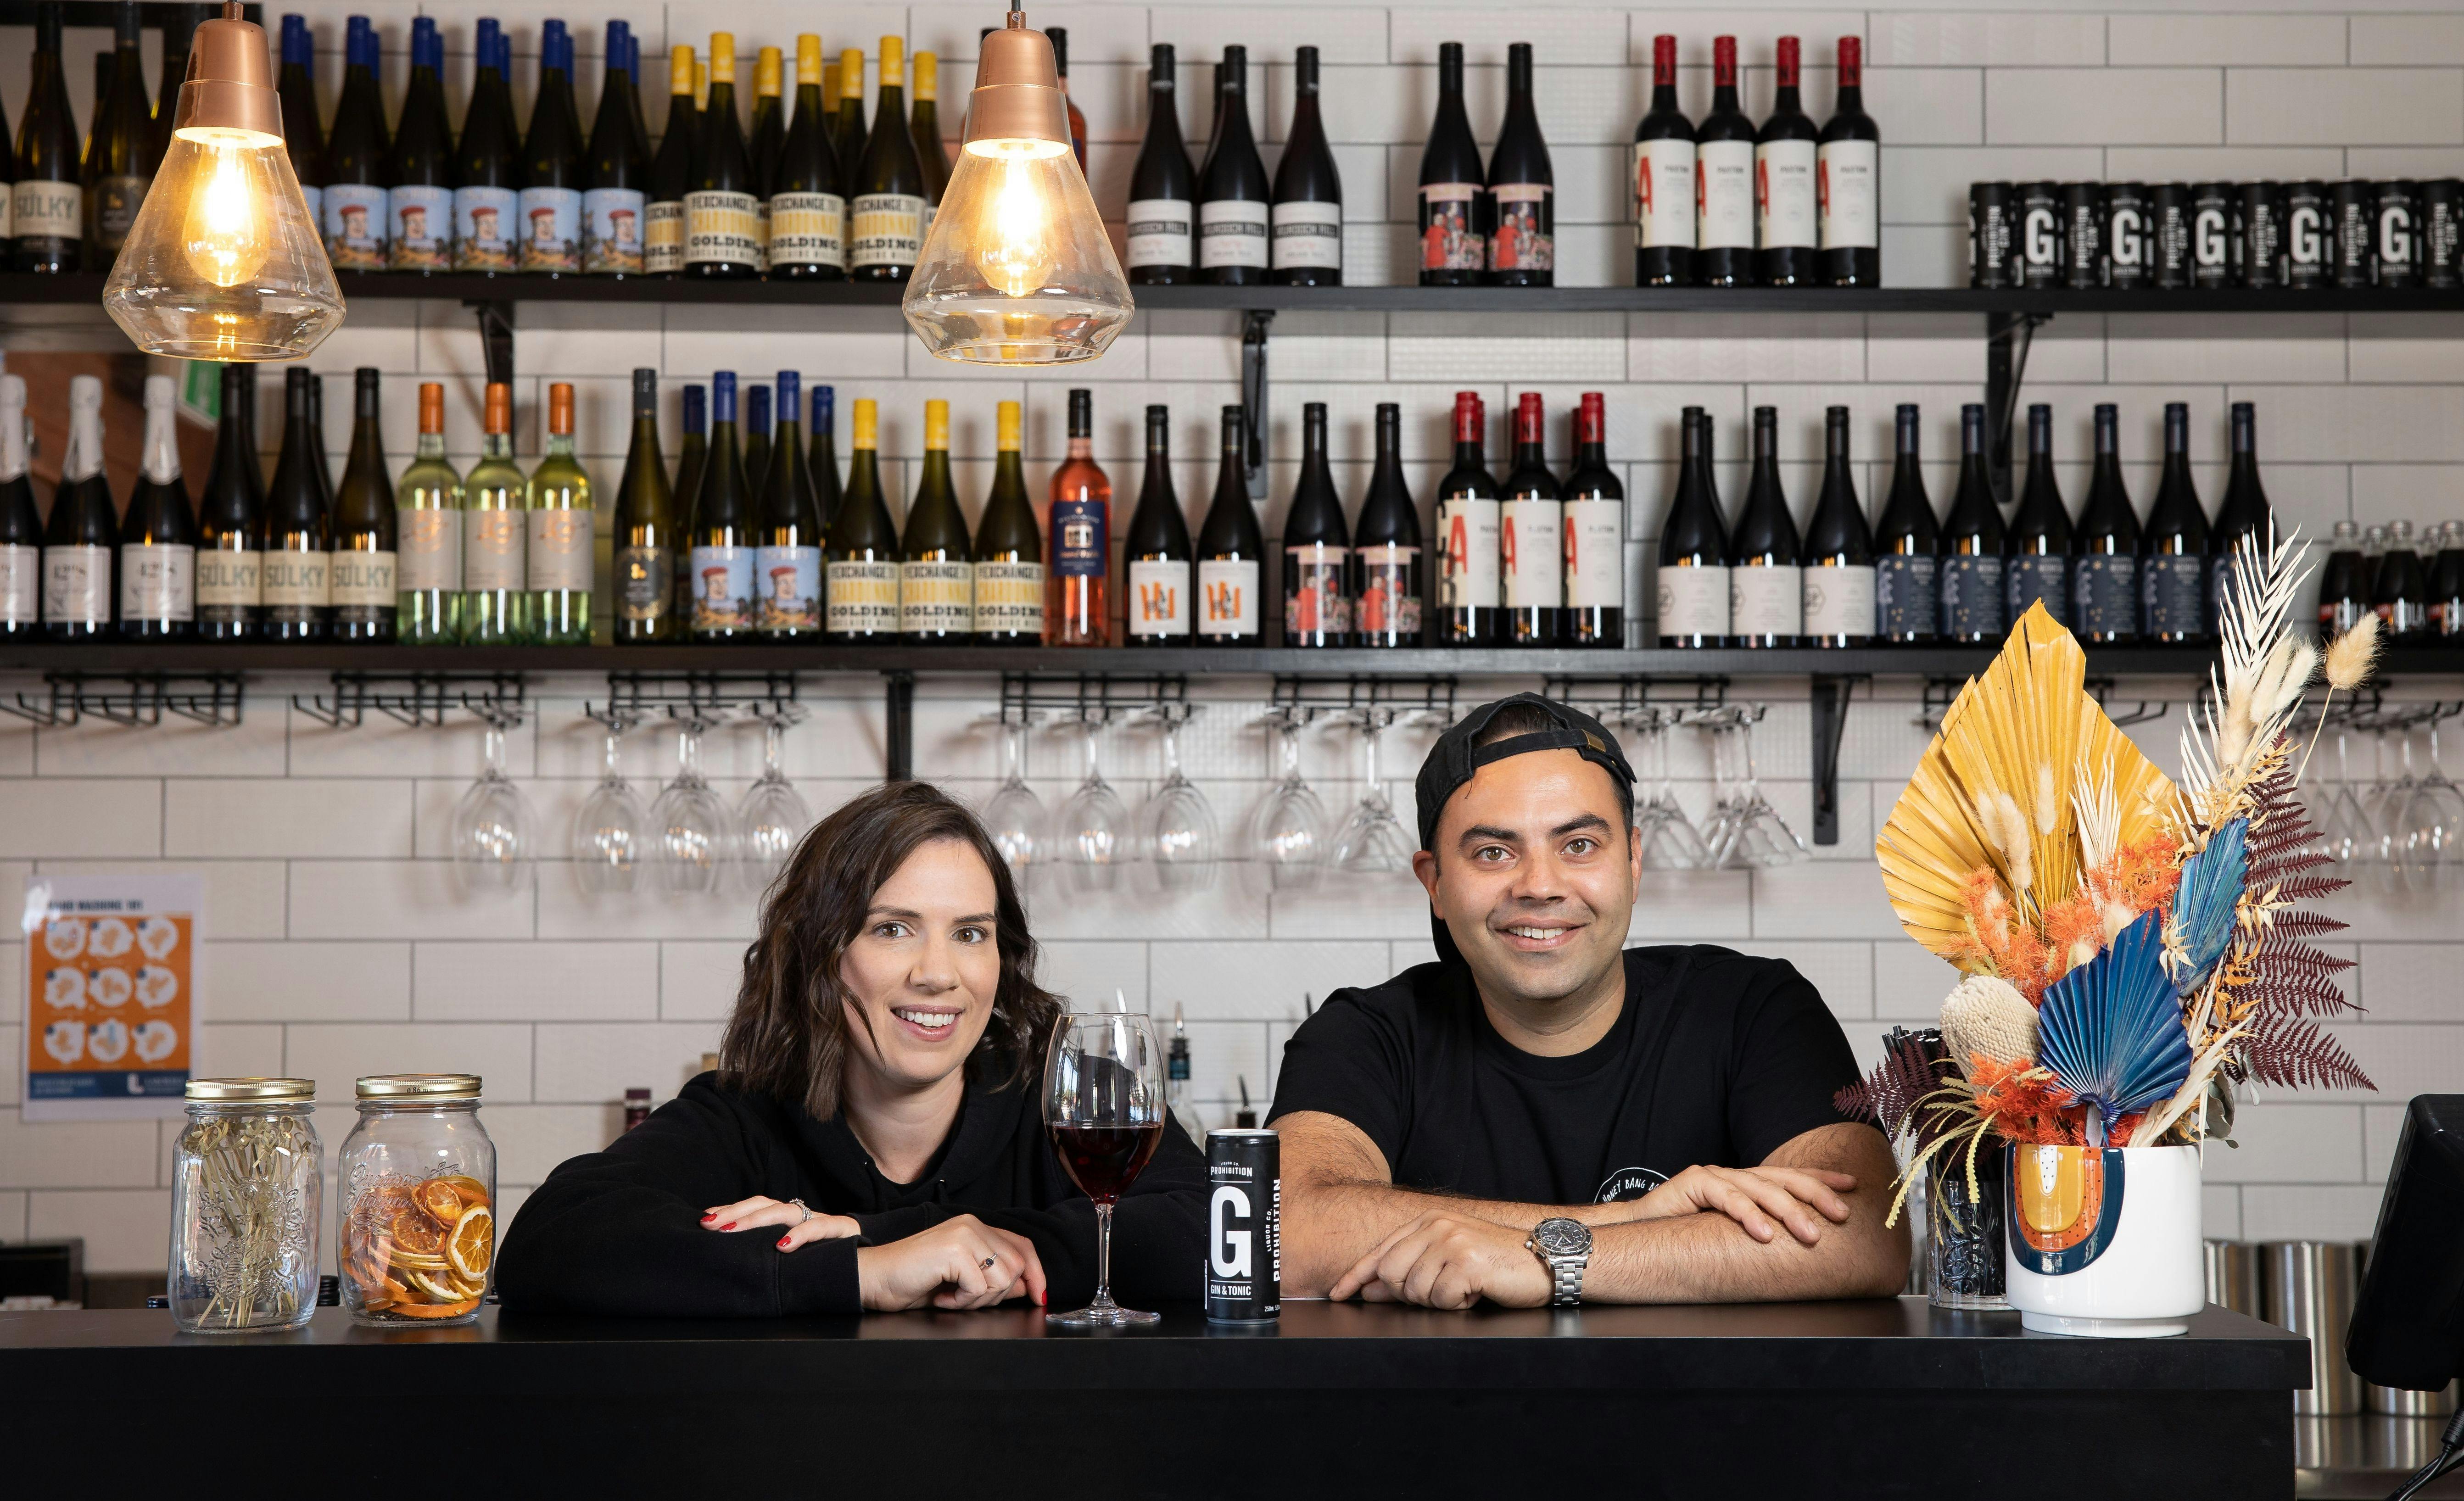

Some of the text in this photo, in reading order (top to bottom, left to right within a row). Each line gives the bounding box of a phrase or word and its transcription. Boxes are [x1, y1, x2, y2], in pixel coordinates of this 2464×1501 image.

[2025, 209, 2055, 265] G
[2112, 209, 2141, 265] G
[2196, 209, 2225, 265] G
[2290, 207, 2321, 264] G
[2380, 207, 2410, 263] G
[1211, 1166, 1252, 1177] PROHIBITION
[1625, 1177, 1646, 1189] BANG
[1211, 1185, 1252, 1278] G
[1211, 1284, 1252, 1296] GIN & TONIC
